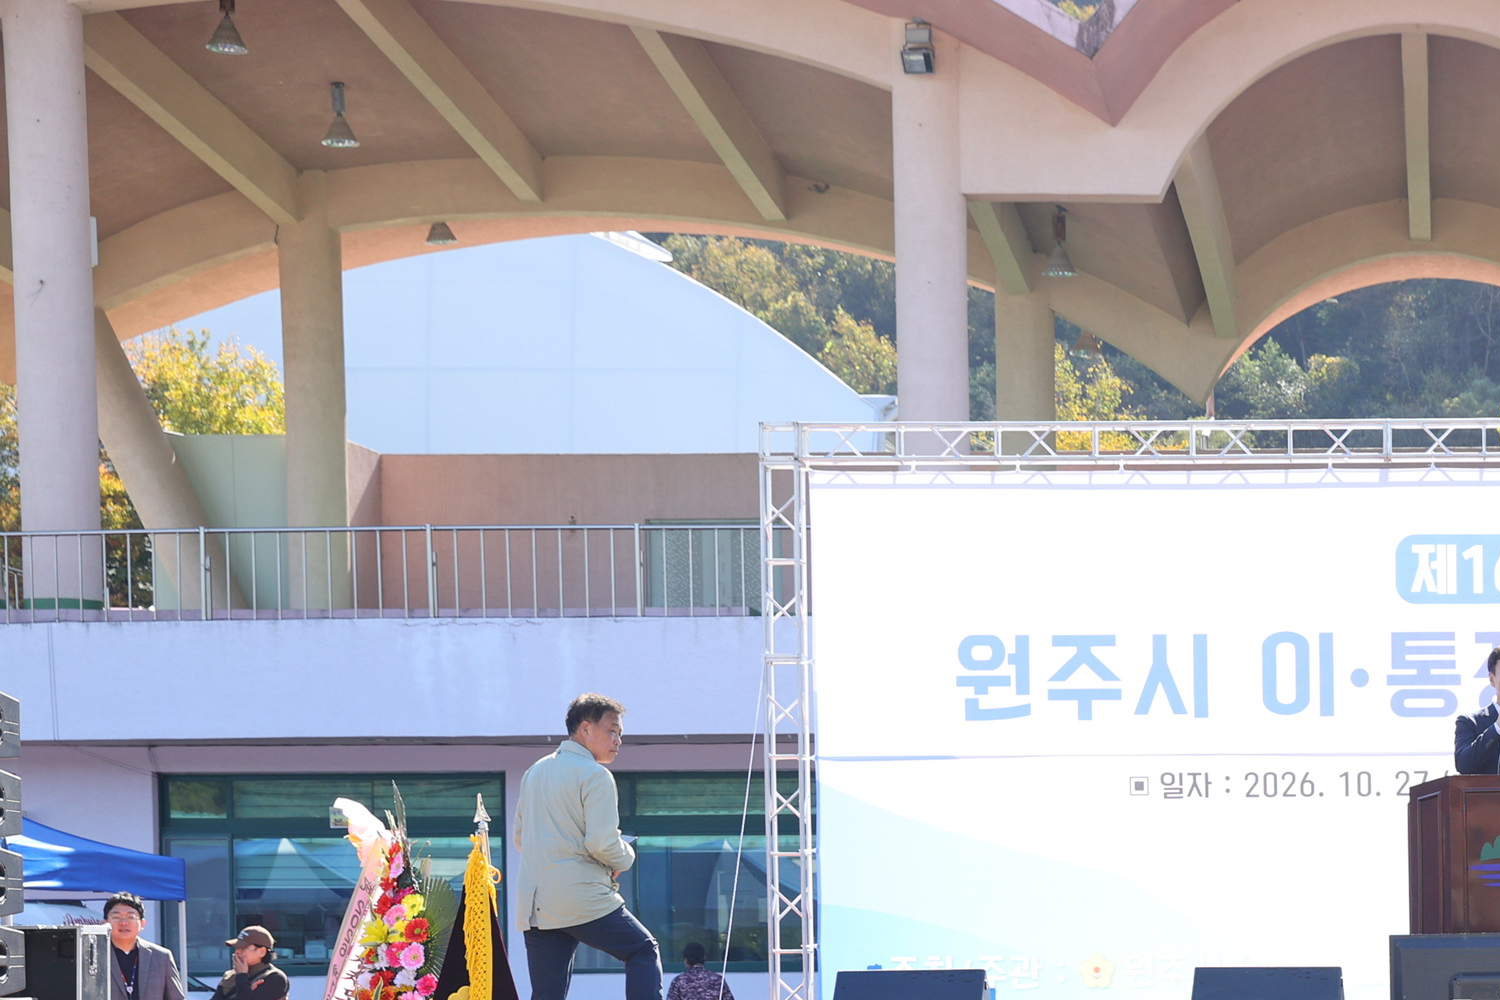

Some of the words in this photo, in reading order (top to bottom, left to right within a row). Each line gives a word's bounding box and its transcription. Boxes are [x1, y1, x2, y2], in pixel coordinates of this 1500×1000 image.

[956, 633, 1209, 721] 원주시
[1160, 771, 1212, 799] 일자
[1244, 771, 1325, 798] 2026.
[1339, 770, 1382, 797] 10.
